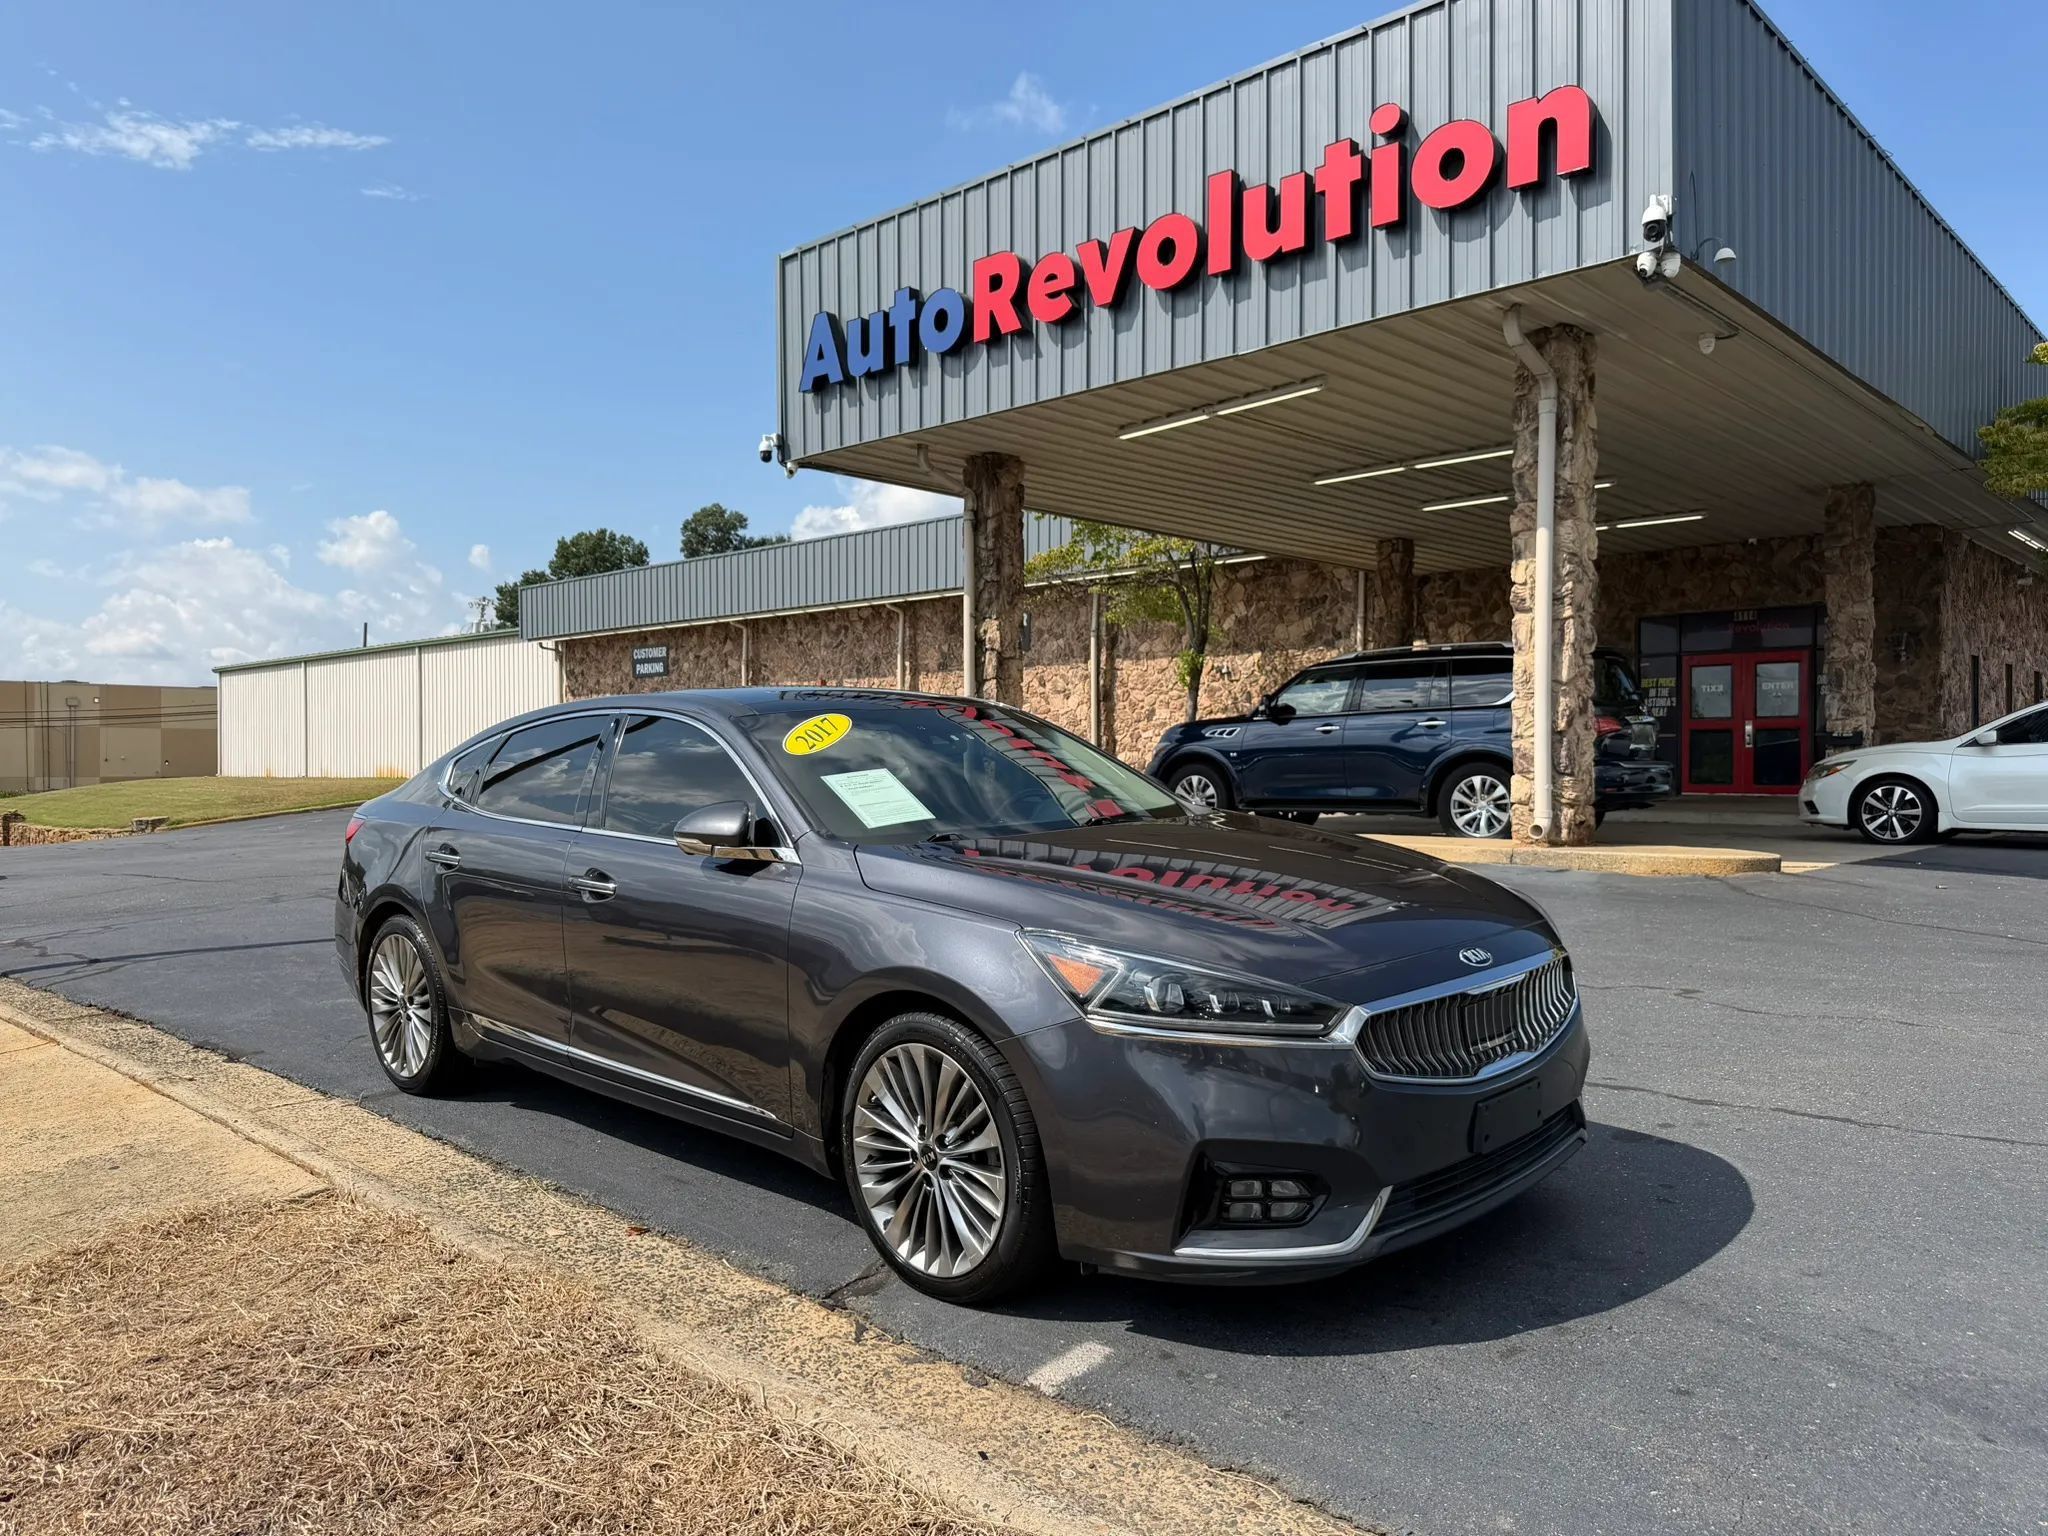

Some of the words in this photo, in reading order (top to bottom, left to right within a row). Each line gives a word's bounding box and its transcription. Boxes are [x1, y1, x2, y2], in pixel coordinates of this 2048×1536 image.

[633, 646, 667, 659] CUSTOMER
[636, 662, 664, 674] PARKING
[1761, 681, 1794, 690] ENTER
[795, 717, 838, 750] 2017
[1463, 948, 1490, 963] KIA
